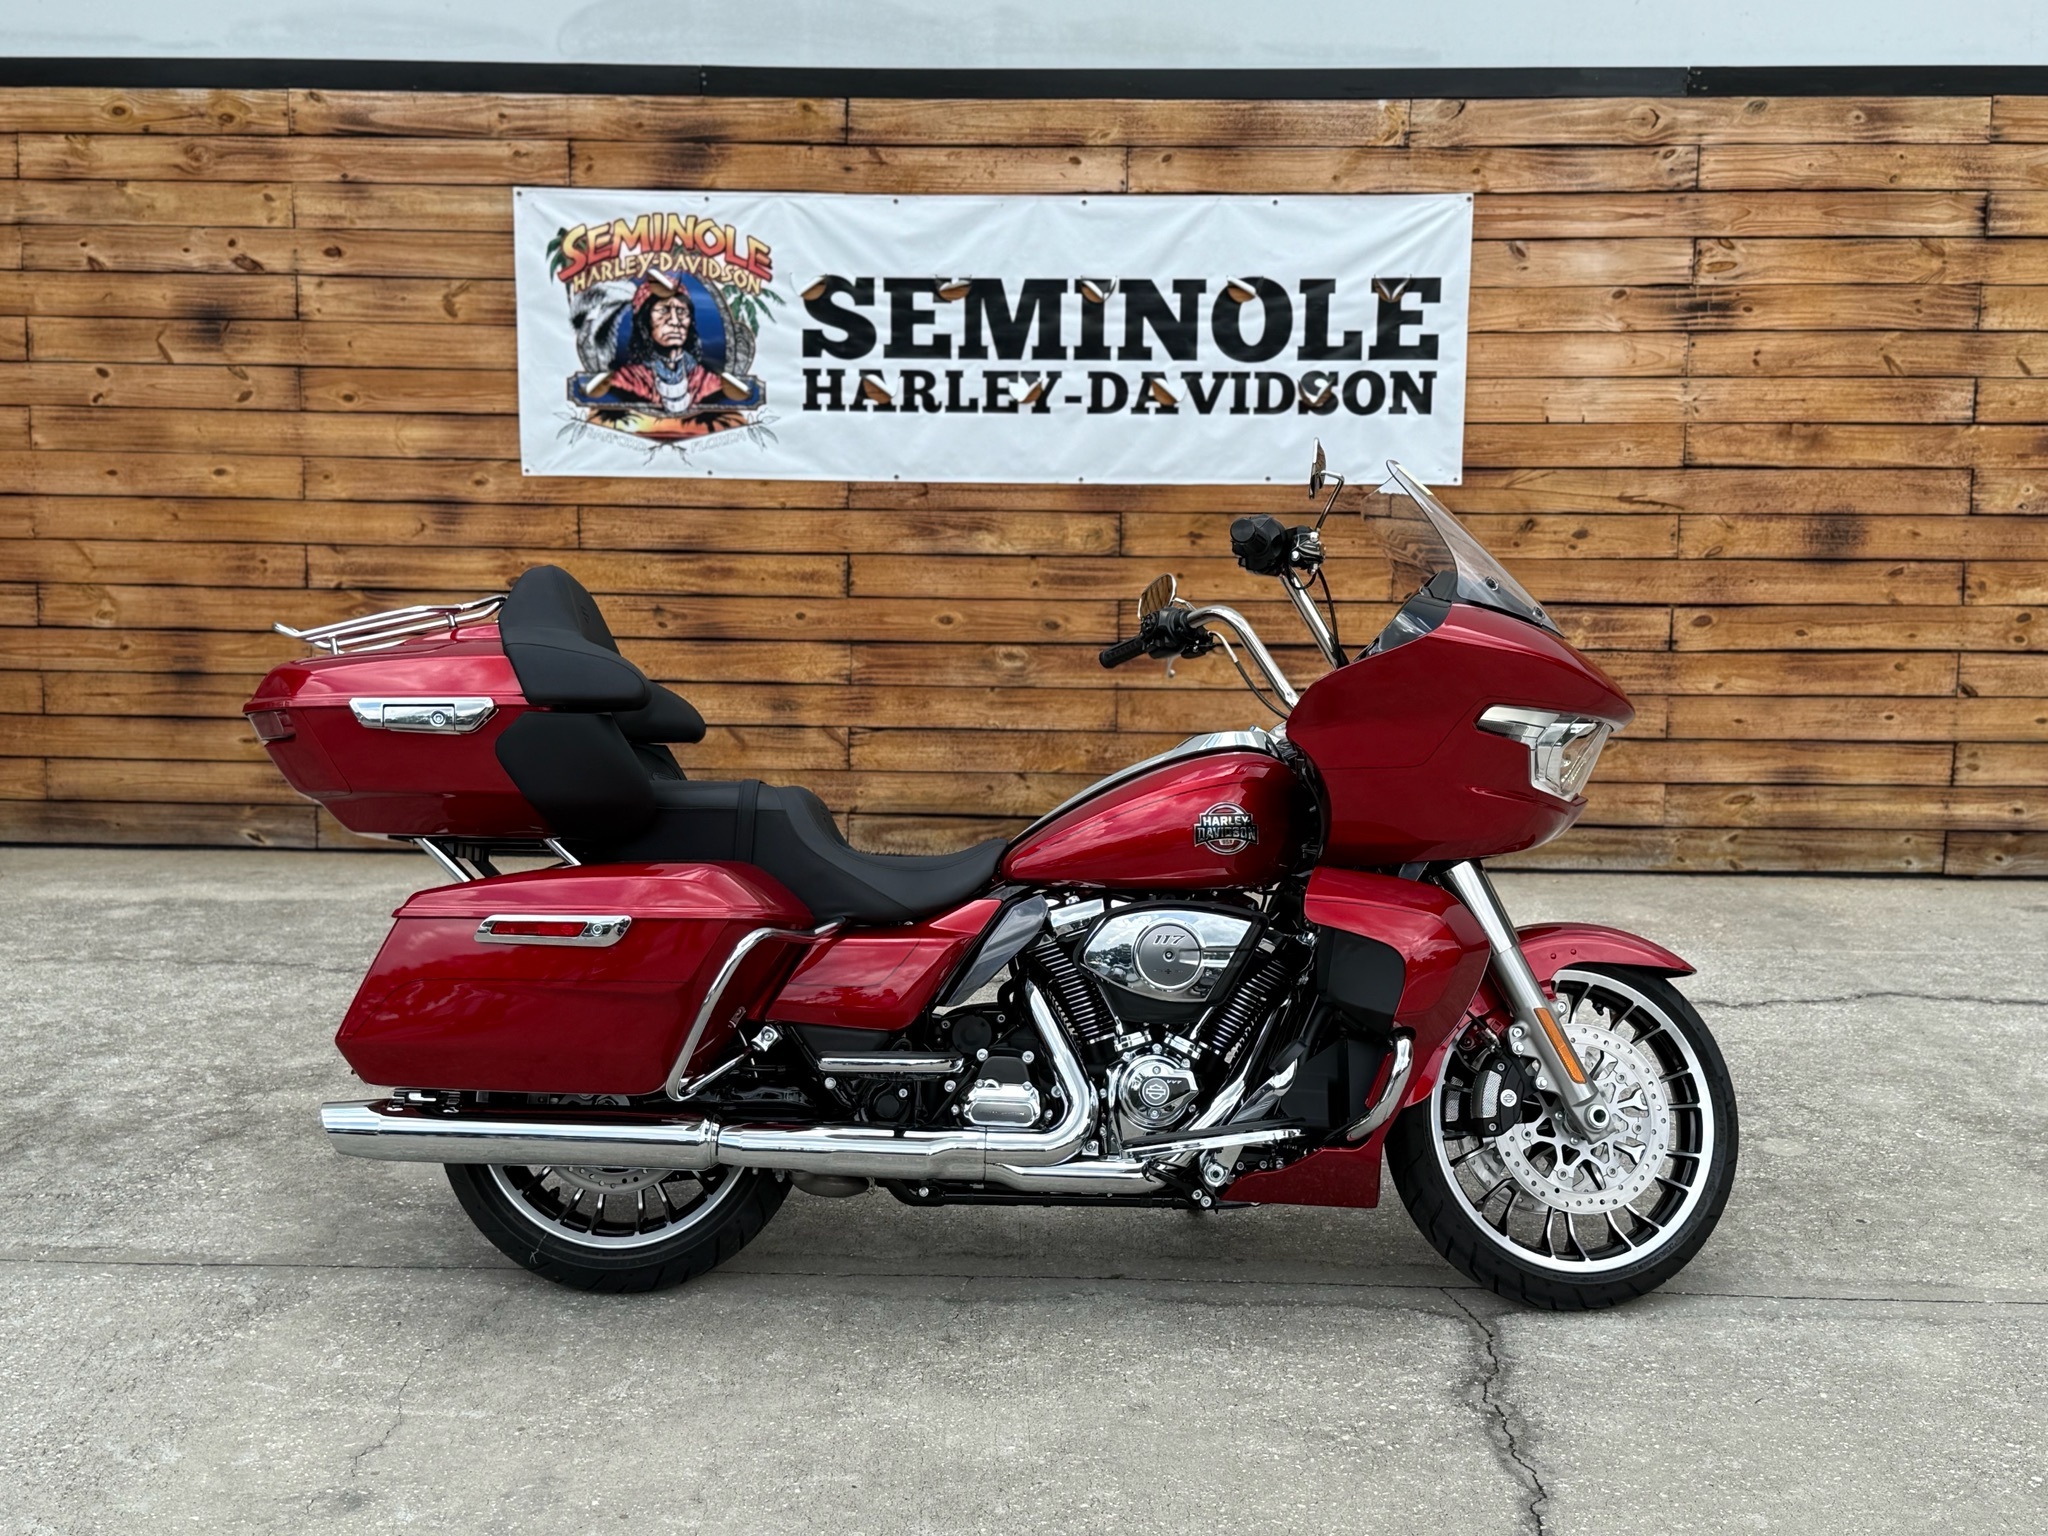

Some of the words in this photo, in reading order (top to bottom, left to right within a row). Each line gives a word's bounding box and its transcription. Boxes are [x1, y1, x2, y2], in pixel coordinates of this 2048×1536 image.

[557, 212, 773, 283] SEMINOLE
[573, 252, 763, 294] HARLEY-DAVIDSON
[801, 274, 1441, 363] SEMINOLE
[802, 368, 1437, 416] HARLEY-DAVIDSON
[1197, 826, 1256, 843] DAVIDSON
[1152, 934, 1186, 945] 117
